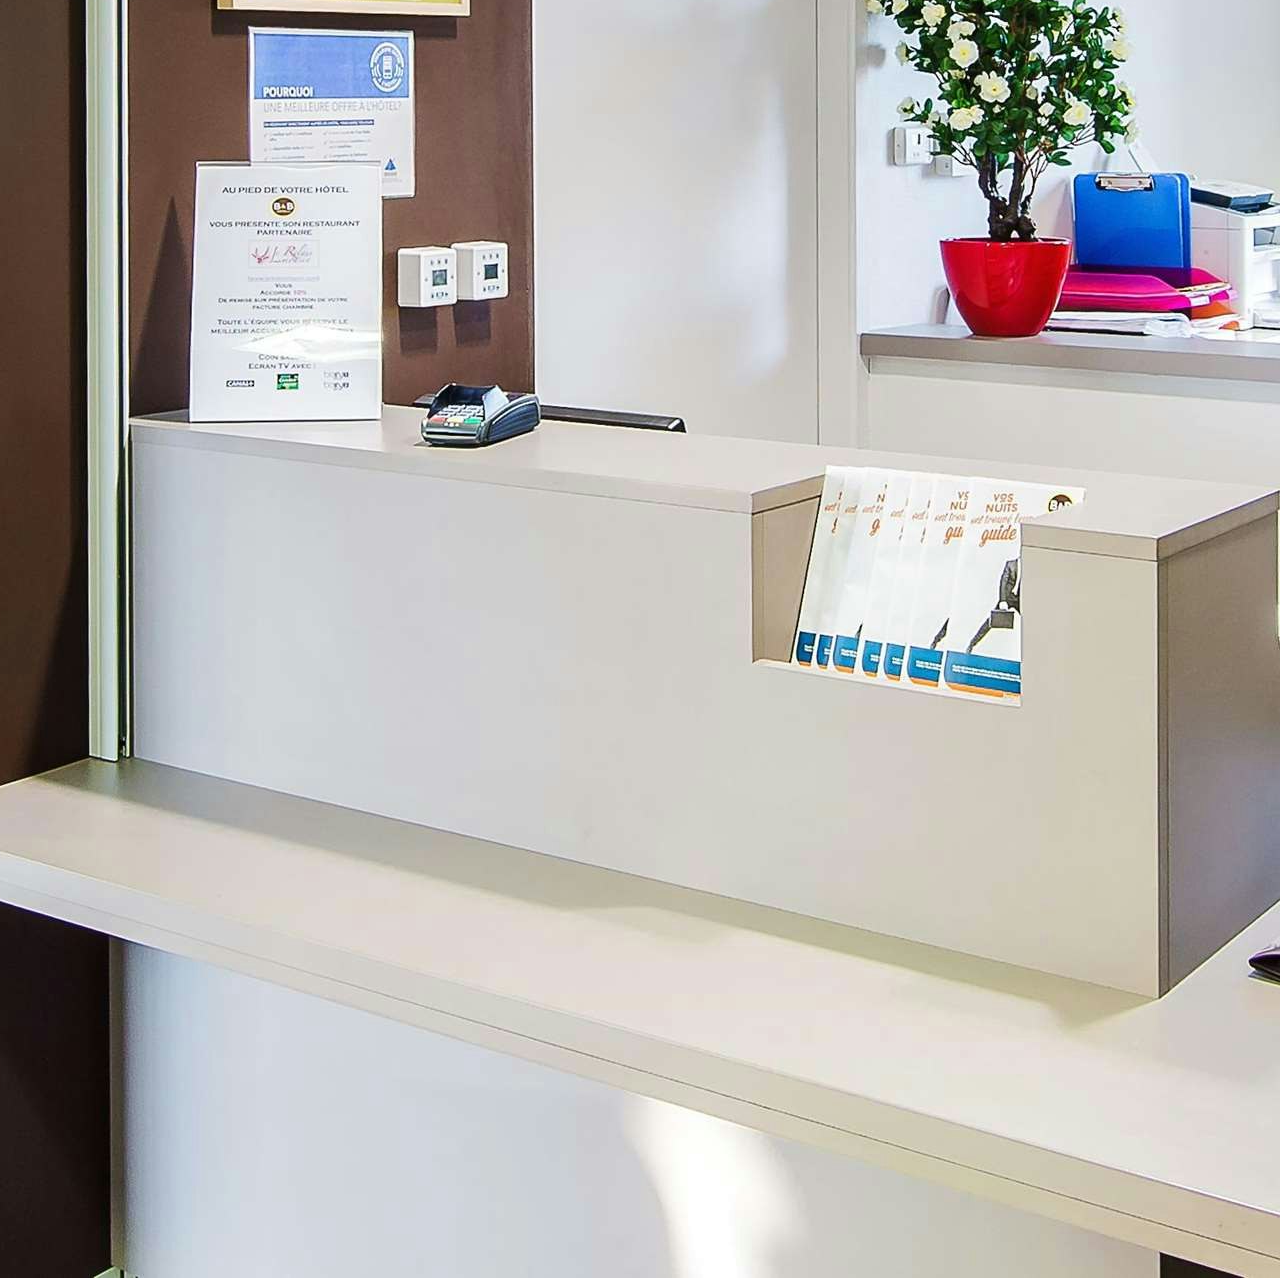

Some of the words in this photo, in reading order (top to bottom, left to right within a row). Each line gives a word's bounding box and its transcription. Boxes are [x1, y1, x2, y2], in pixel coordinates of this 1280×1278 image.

[263, 86, 313, 98] POURQUOI
[263, 103, 282, 113] UNE
[284, 102, 330, 113] MEILLEURE
[222, 186, 236, 194] AU
[238, 186, 262, 194] PIED
[280, 186, 313, 194] VOTRE
[993, 493, 1014, 502] VOS
[985, 503, 1018, 513] NUITS
[979, 524, 1017, 547] guide
